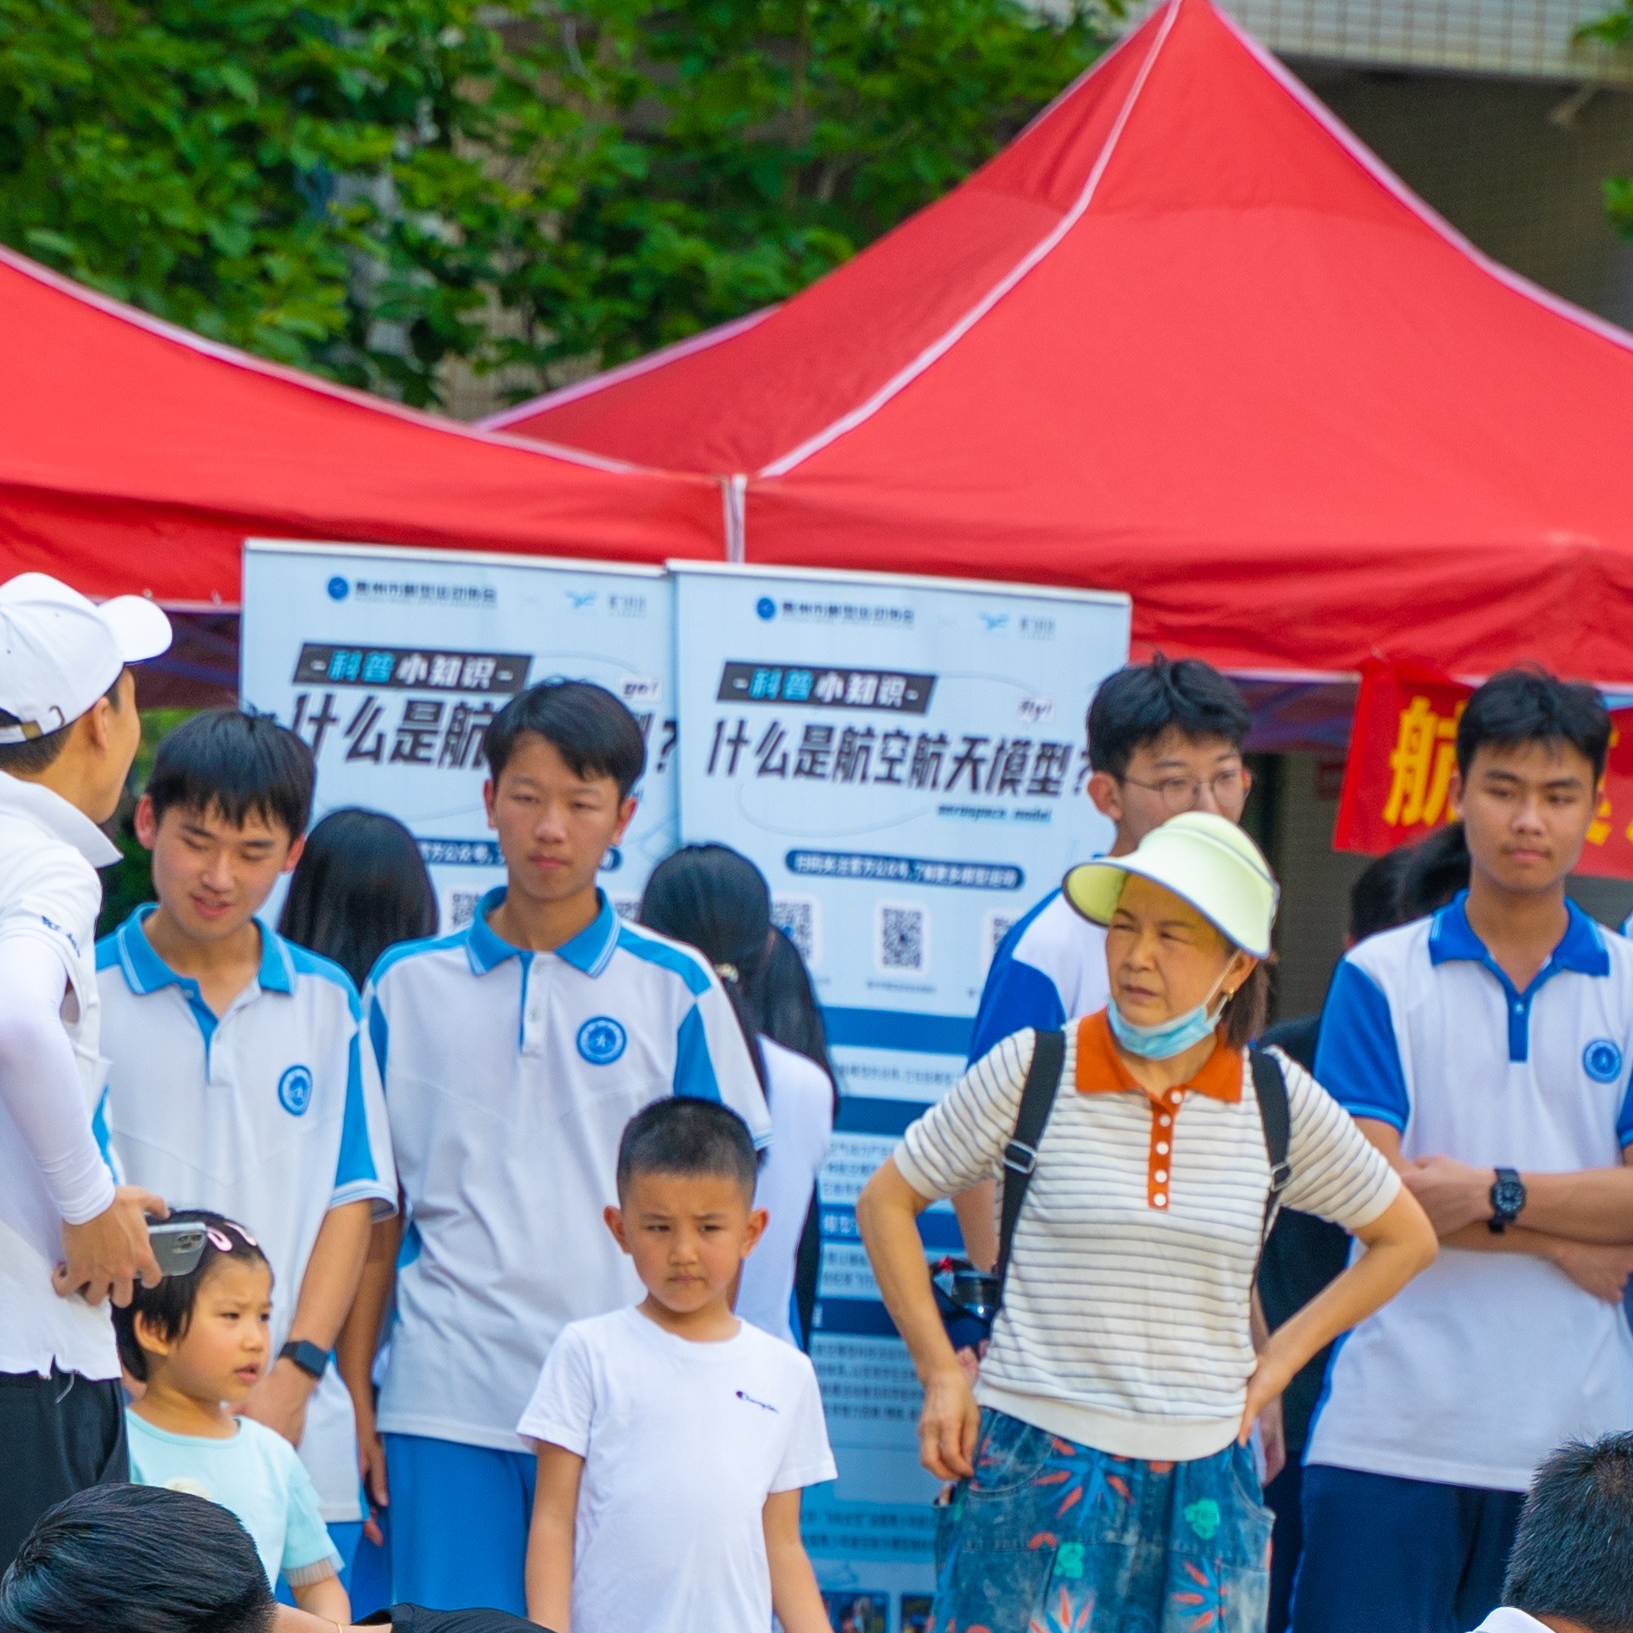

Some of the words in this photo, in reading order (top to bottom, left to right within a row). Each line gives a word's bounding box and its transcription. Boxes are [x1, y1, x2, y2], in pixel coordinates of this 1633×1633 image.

[708, 719, 1089, 797] 什么是航空航天模型？
